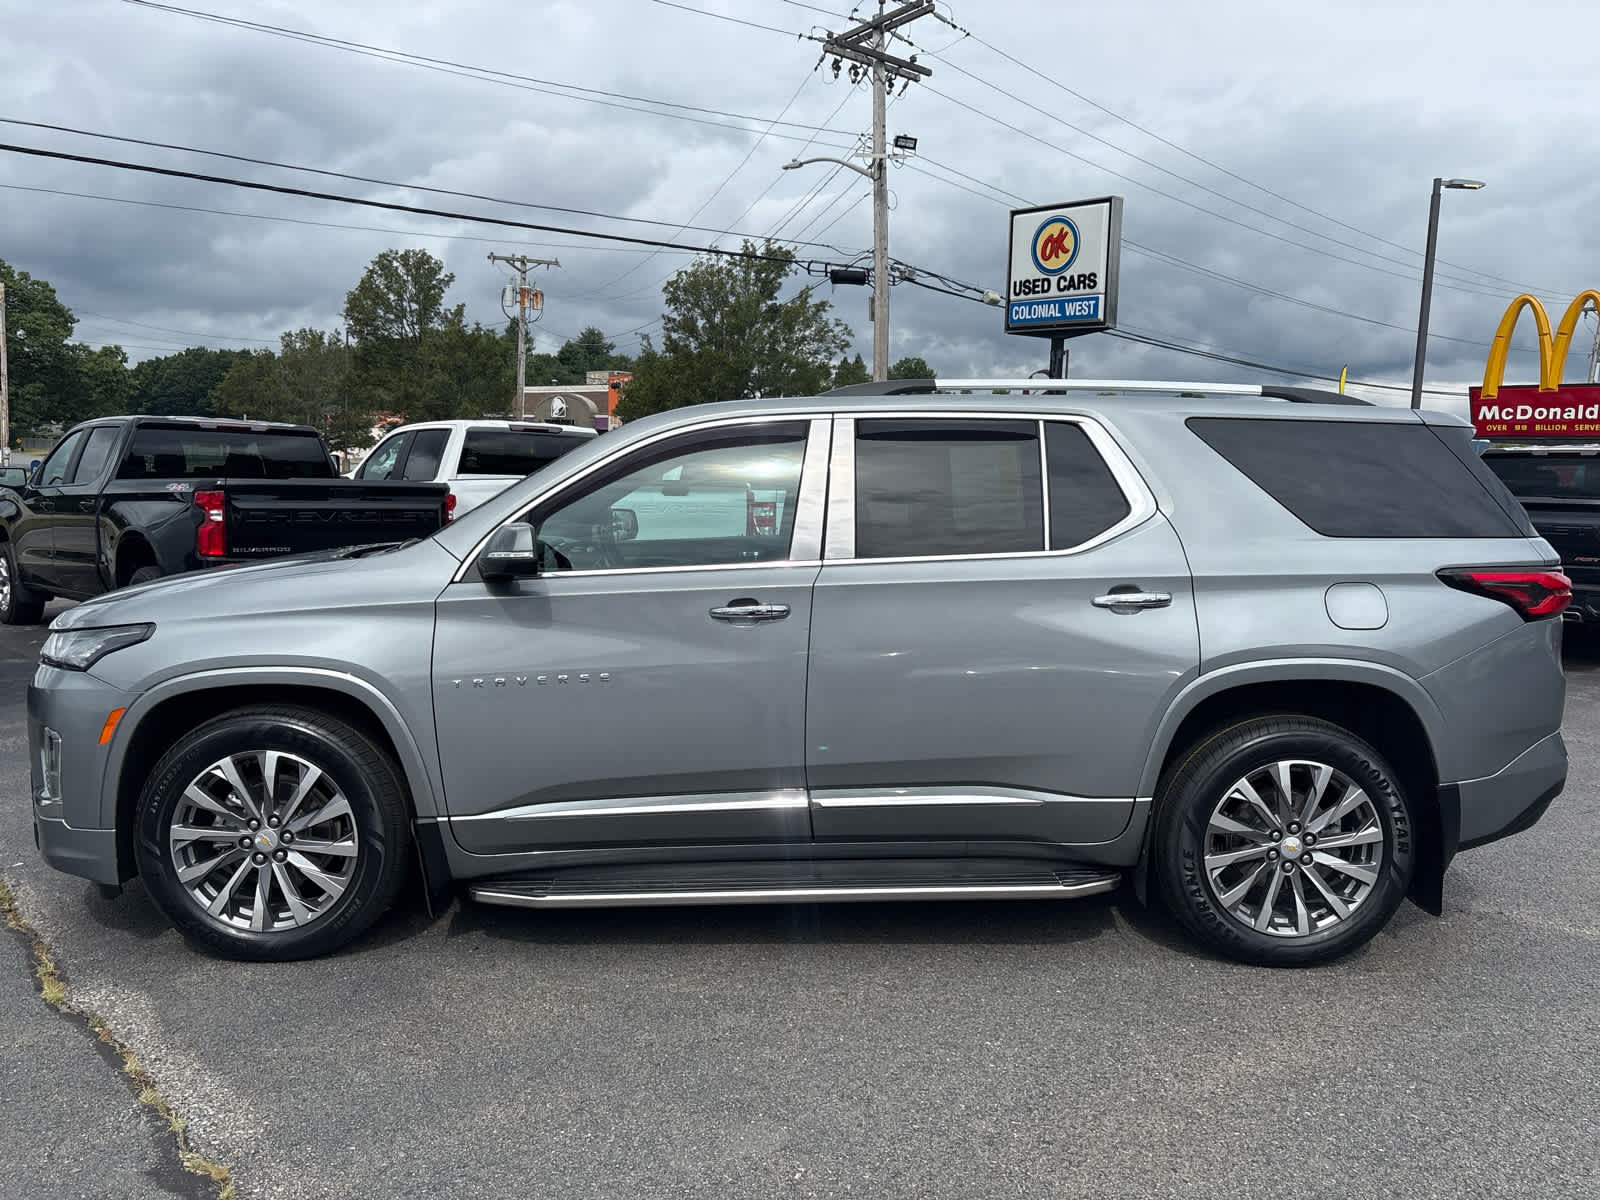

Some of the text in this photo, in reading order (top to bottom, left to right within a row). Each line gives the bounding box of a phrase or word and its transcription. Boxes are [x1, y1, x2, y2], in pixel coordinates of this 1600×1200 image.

[1041, 226, 1070, 262] OK
[1013, 272, 1098, 296] USED CARS
[1012, 300, 1096, 320] COLONIAL WEST
[452, 672, 609, 689] TRAVERSE
